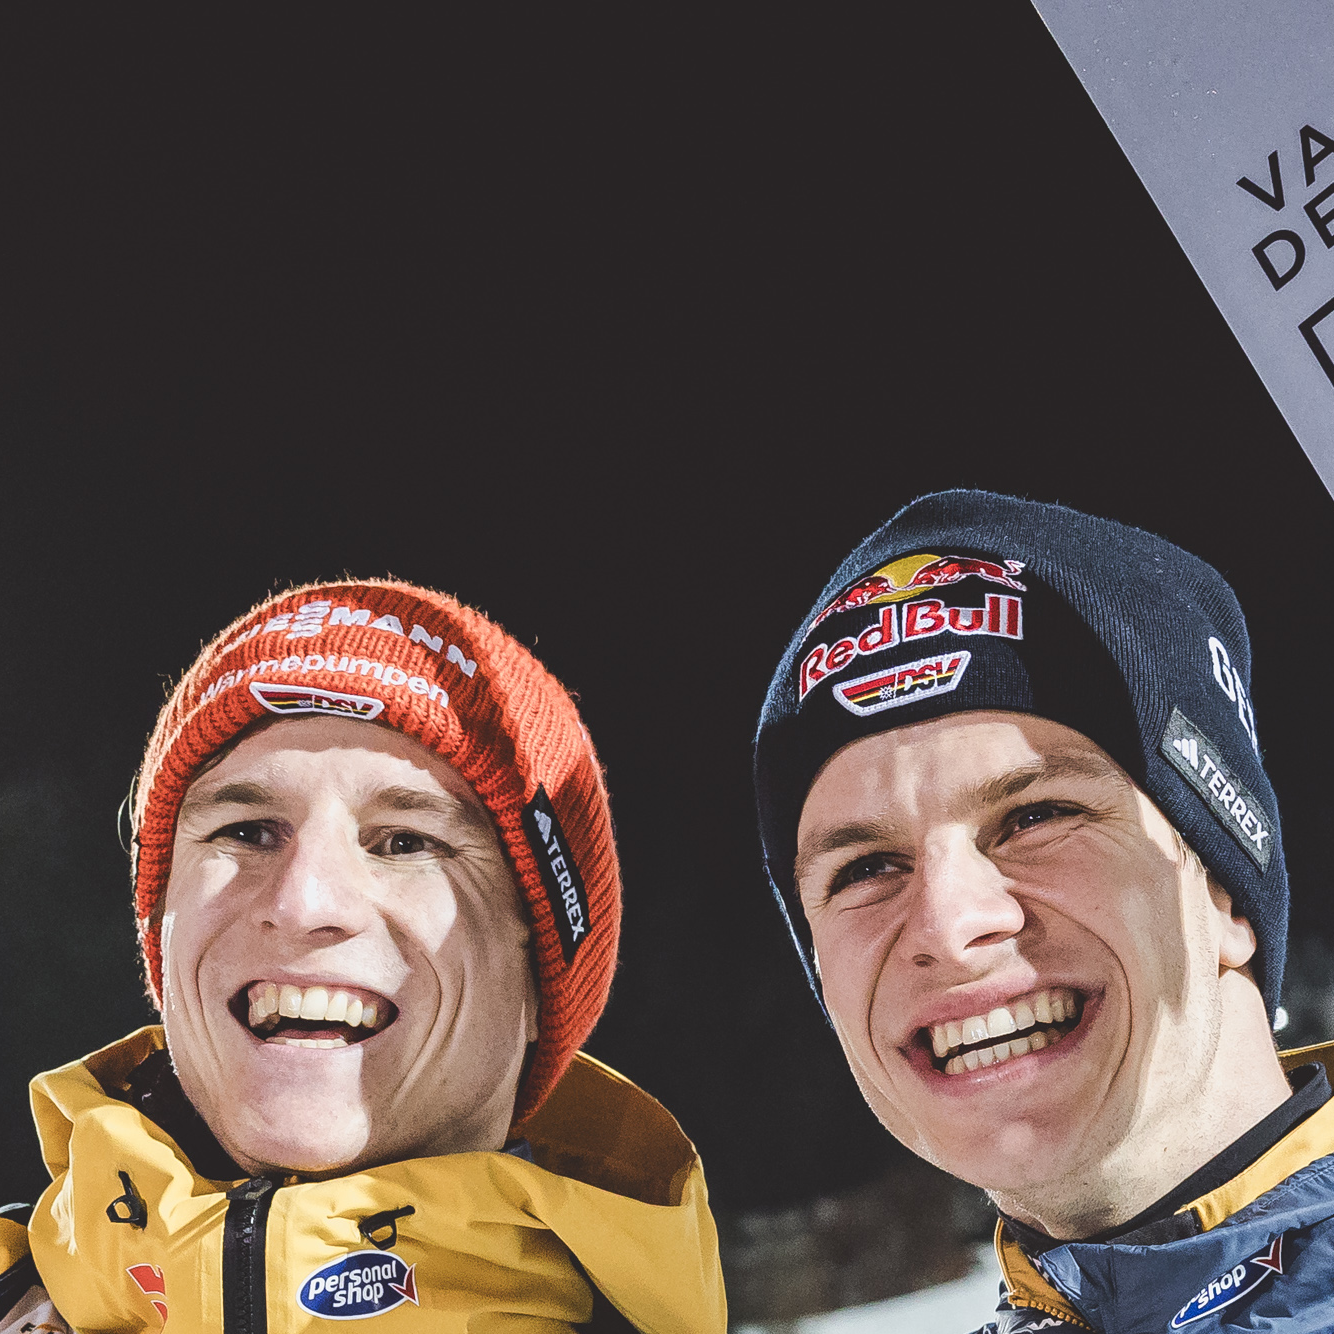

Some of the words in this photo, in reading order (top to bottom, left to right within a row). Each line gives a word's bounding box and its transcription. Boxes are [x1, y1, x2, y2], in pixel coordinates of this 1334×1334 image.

[799, 603, 899, 702] Red
[902, 593, 1024, 643] Bull
[1199, 753, 1269, 851] TERREX
[547, 835, 585, 942] TERREX
[308, 1260, 397, 1300] personal
[332, 1282, 384, 1308] shop
[1197, 1264, 1246, 1309] shop
